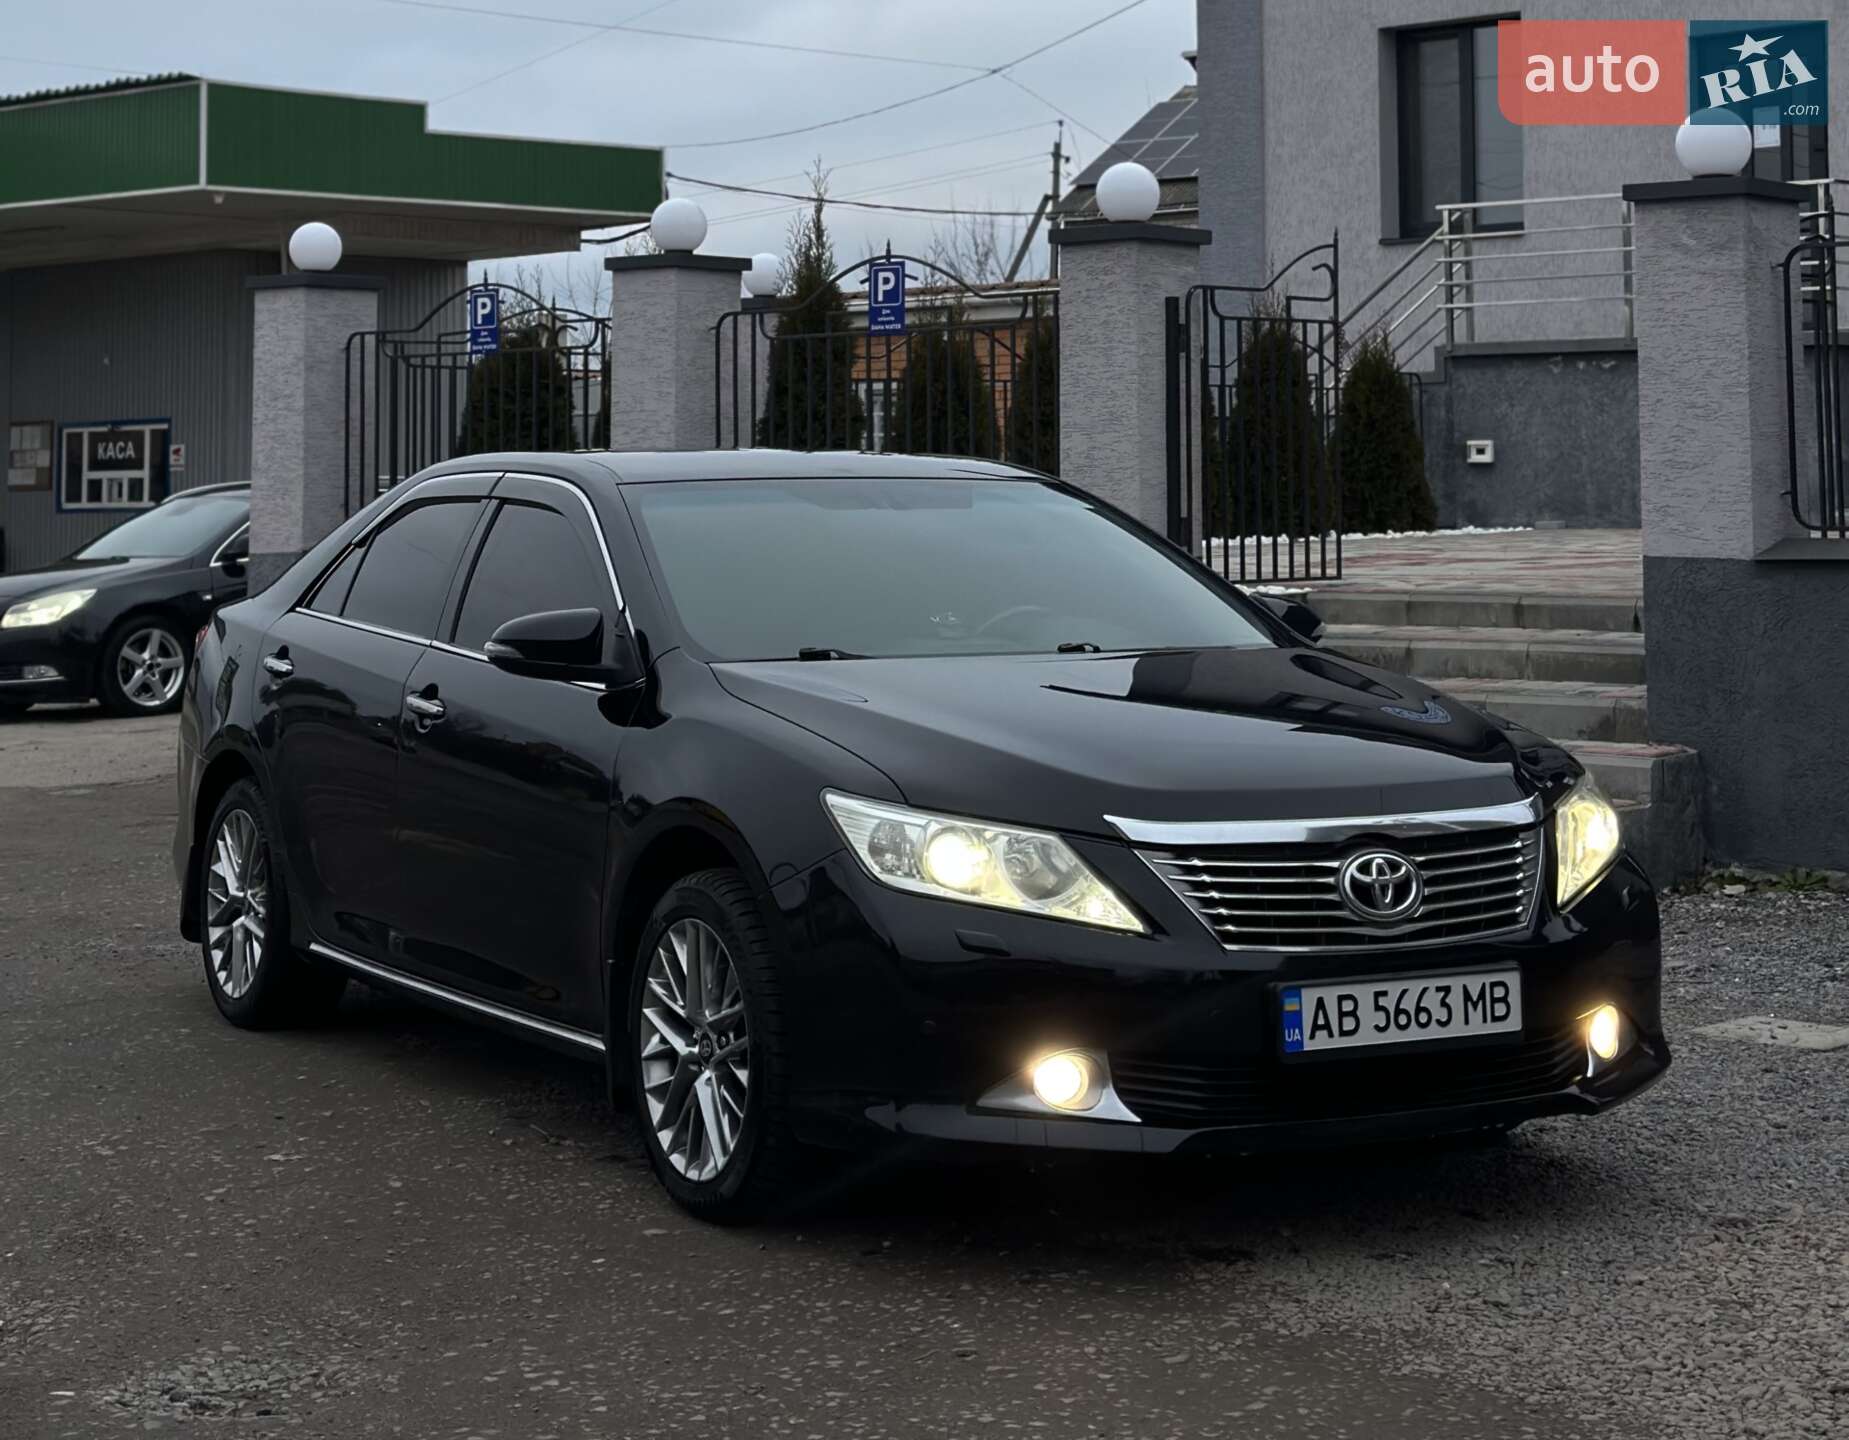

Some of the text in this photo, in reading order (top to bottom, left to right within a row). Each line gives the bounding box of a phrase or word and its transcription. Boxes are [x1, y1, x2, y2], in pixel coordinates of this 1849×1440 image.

[878, 271, 895, 302] P
[476, 297, 492, 325] P
[97, 441, 135, 461] КАСА
[1309, 980, 1512, 1041] AB 5663 MB
[1285, 1027, 1302, 1043] UA
